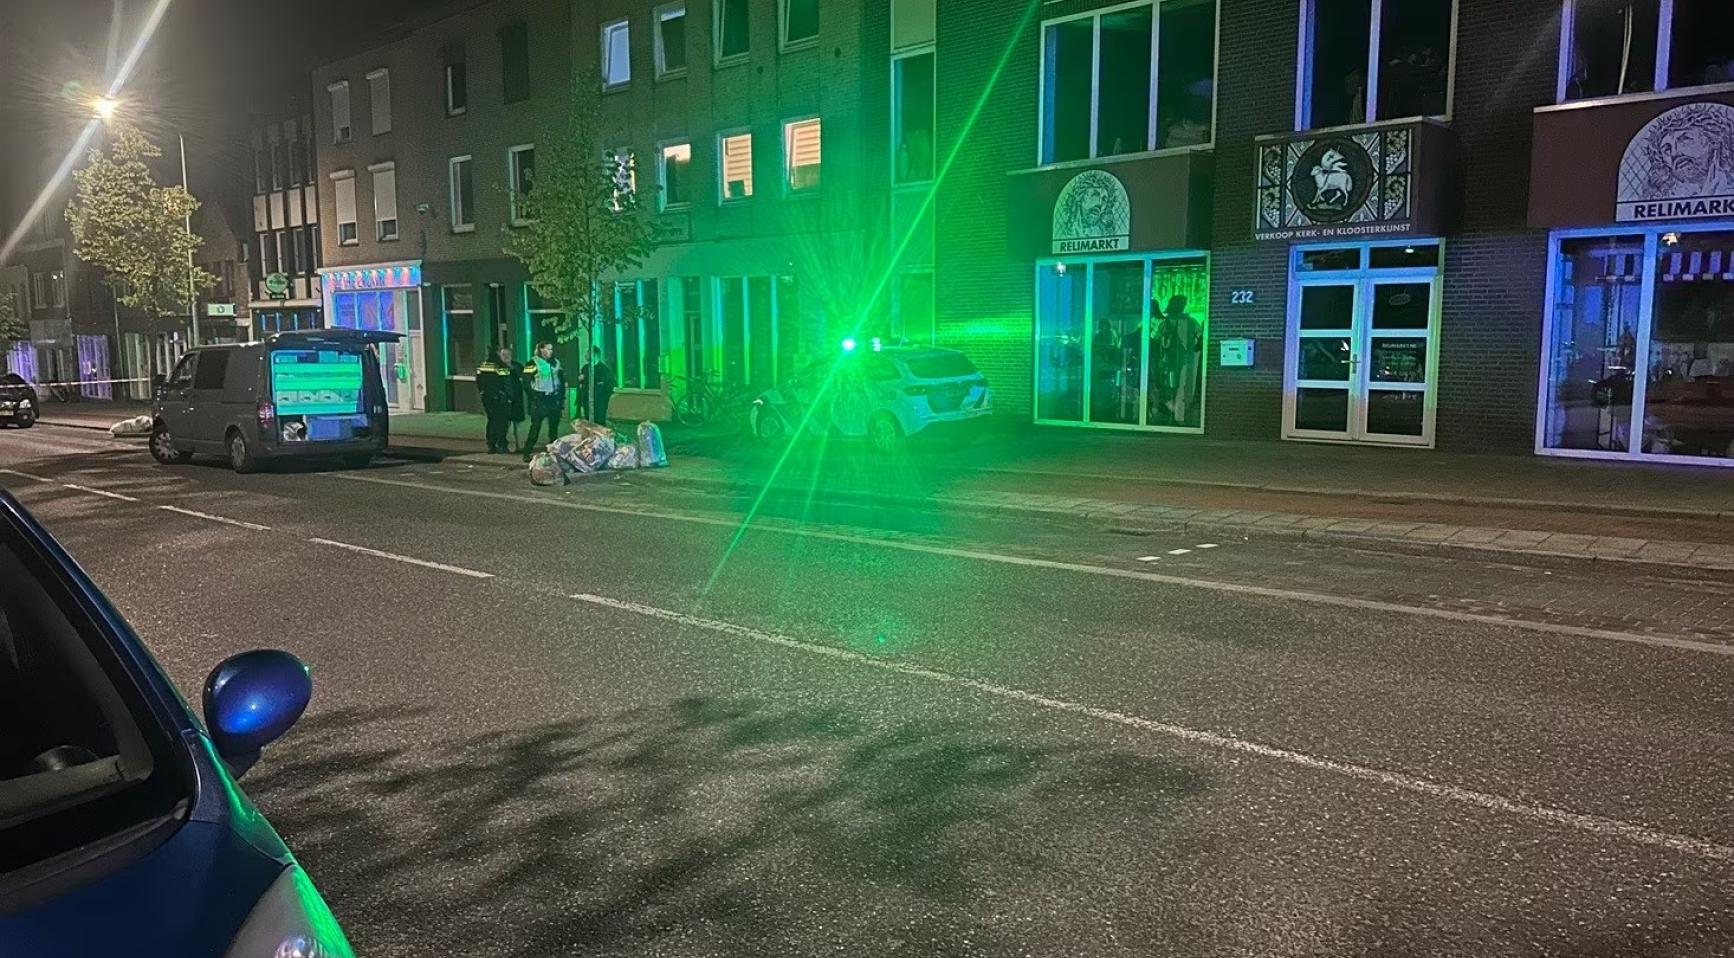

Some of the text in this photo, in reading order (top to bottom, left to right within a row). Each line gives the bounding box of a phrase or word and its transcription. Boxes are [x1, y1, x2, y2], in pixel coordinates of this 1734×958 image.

[1255, 223, 1410, 241] VERKOOP KERK- EN KLOOSTERKUNST
[1060, 239, 1119, 252] RELIMARKT
[1232, 290, 1253, 304] 232
